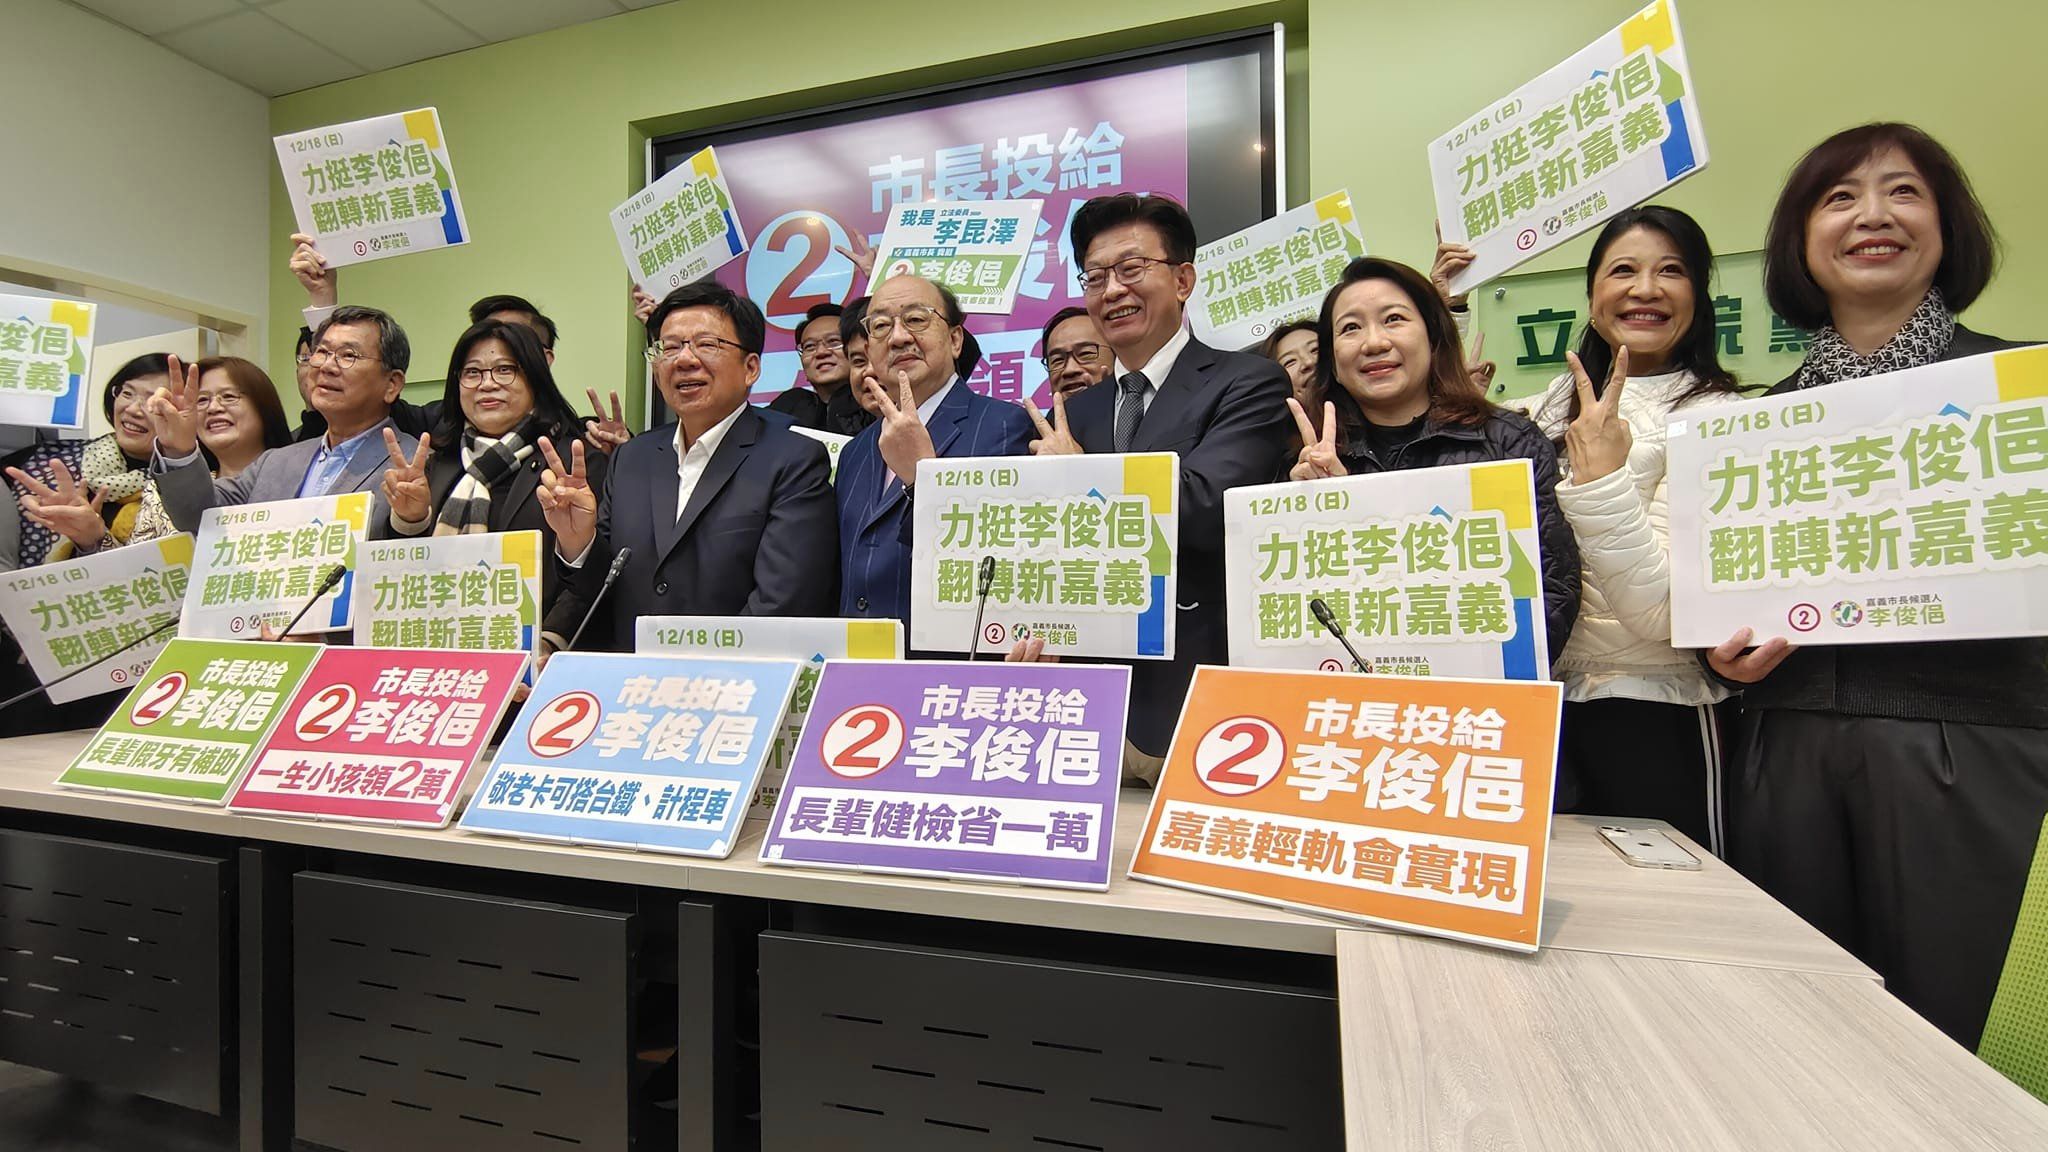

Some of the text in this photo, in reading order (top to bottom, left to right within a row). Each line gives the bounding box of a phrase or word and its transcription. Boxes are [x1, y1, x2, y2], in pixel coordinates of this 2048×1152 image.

[290, 137, 321, 153] 12/18
[1445, 118, 1490, 151] 12/18
[1457, 52, 1655, 196] 力挺李俊俋
[302, 143, 431, 196] 力挺李俊俋
[868, 121, 1125, 213] 市長投給
[1463, 101, 1665, 242] 翻轉新嘉義
[310, 182, 442, 235] 翻轉新嘉義
[630, 177, 716, 250] 力挺李俊俋
[900, 209, 936, 227] 我是
[933, 218, 1019, 245] 李昆澤
[638, 208, 726, 279] 翻轉新嘉義
[767, 216, 831, 317] 2
[1197, 247, 1225, 263] 2/18
[1200, 222, 1342, 297] 力挺李俊俋
[919, 260, 1003, 287] 李俊俋
[1696, 410, 1771, 439] 12/18
[935, 470, 984, 487] 12/18
[1708, 406, 2048, 515] 力挺李俊俋
[215, 512, 248, 526] 12/18
[940, 501, 1146, 549] 力挺李俊俋
[1249, 494, 1308, 516] 12/18
[210, 523, 347, 568] 力挺李俊俋
[370, 548, 406, 562] 12/18
[1258, 517, 1504, 582] 力挺李俊俋
[1709, 488, 2048, 584] 翻轉新嘉義
[8, 573, 59, 593] 12/18
[30, 567, 188, 632] 力挺李俊俋
[374, 569, 518, 612] 力挺李俊俋
[938, 558, 1145, 606] 翻轉新嘉義
[1866, 594, 1942, 607] 嘉義市長候選人
[372, 614, 518, 650] 翻轉新嘉義
[1032, 622, 1077, 630] 嘉義市長候選人
[1258, 581, 1509, 641] 翻轉新嘉義
[1867, 604, 1946, 628] 李俊俋
[47, 610, 182, 668] 翻轉新嘉
[657, 629, 708, 645] 12/18
[1375, 656, 1429, 664] 嘉義市長候選人
[135, 675, 183, 719] 2
[199, 657, 289, 689] 市長投給
[371, 666, 490, 700] 市長投給
[617, 674, 757, 714] 市長投給
[171, 686, 281, 732] 李俊俋
[299, 687, 350, 735] 2
[345, 698, 486, 747] 李俊俋
[535, 697, 591, 749] 2
[920, 684, 1089, 726] 市長投給
[1304, 697, 1507, 752] 市長投給
[88, 736, 242, 777] 長輩假牙有補助
[592, 709, 758, 767] 李俊俋
[833, 710, 890, 769] 2
[904, 722, 1101, 787] 李俊俋
[1206, 722, 1270, 787] 2
[258, 760, 451, 800] 一生小孩領2萬
[488, 771, 733, 825] 敬老卡可搭台鐵、計程車
[1285, 740, 1525, 823] 李俊俋
[791, 796, 1093, 853] 長輩健檢省一萬
[1159, 809, 1517, 903] 嘉義輕軌會實現
